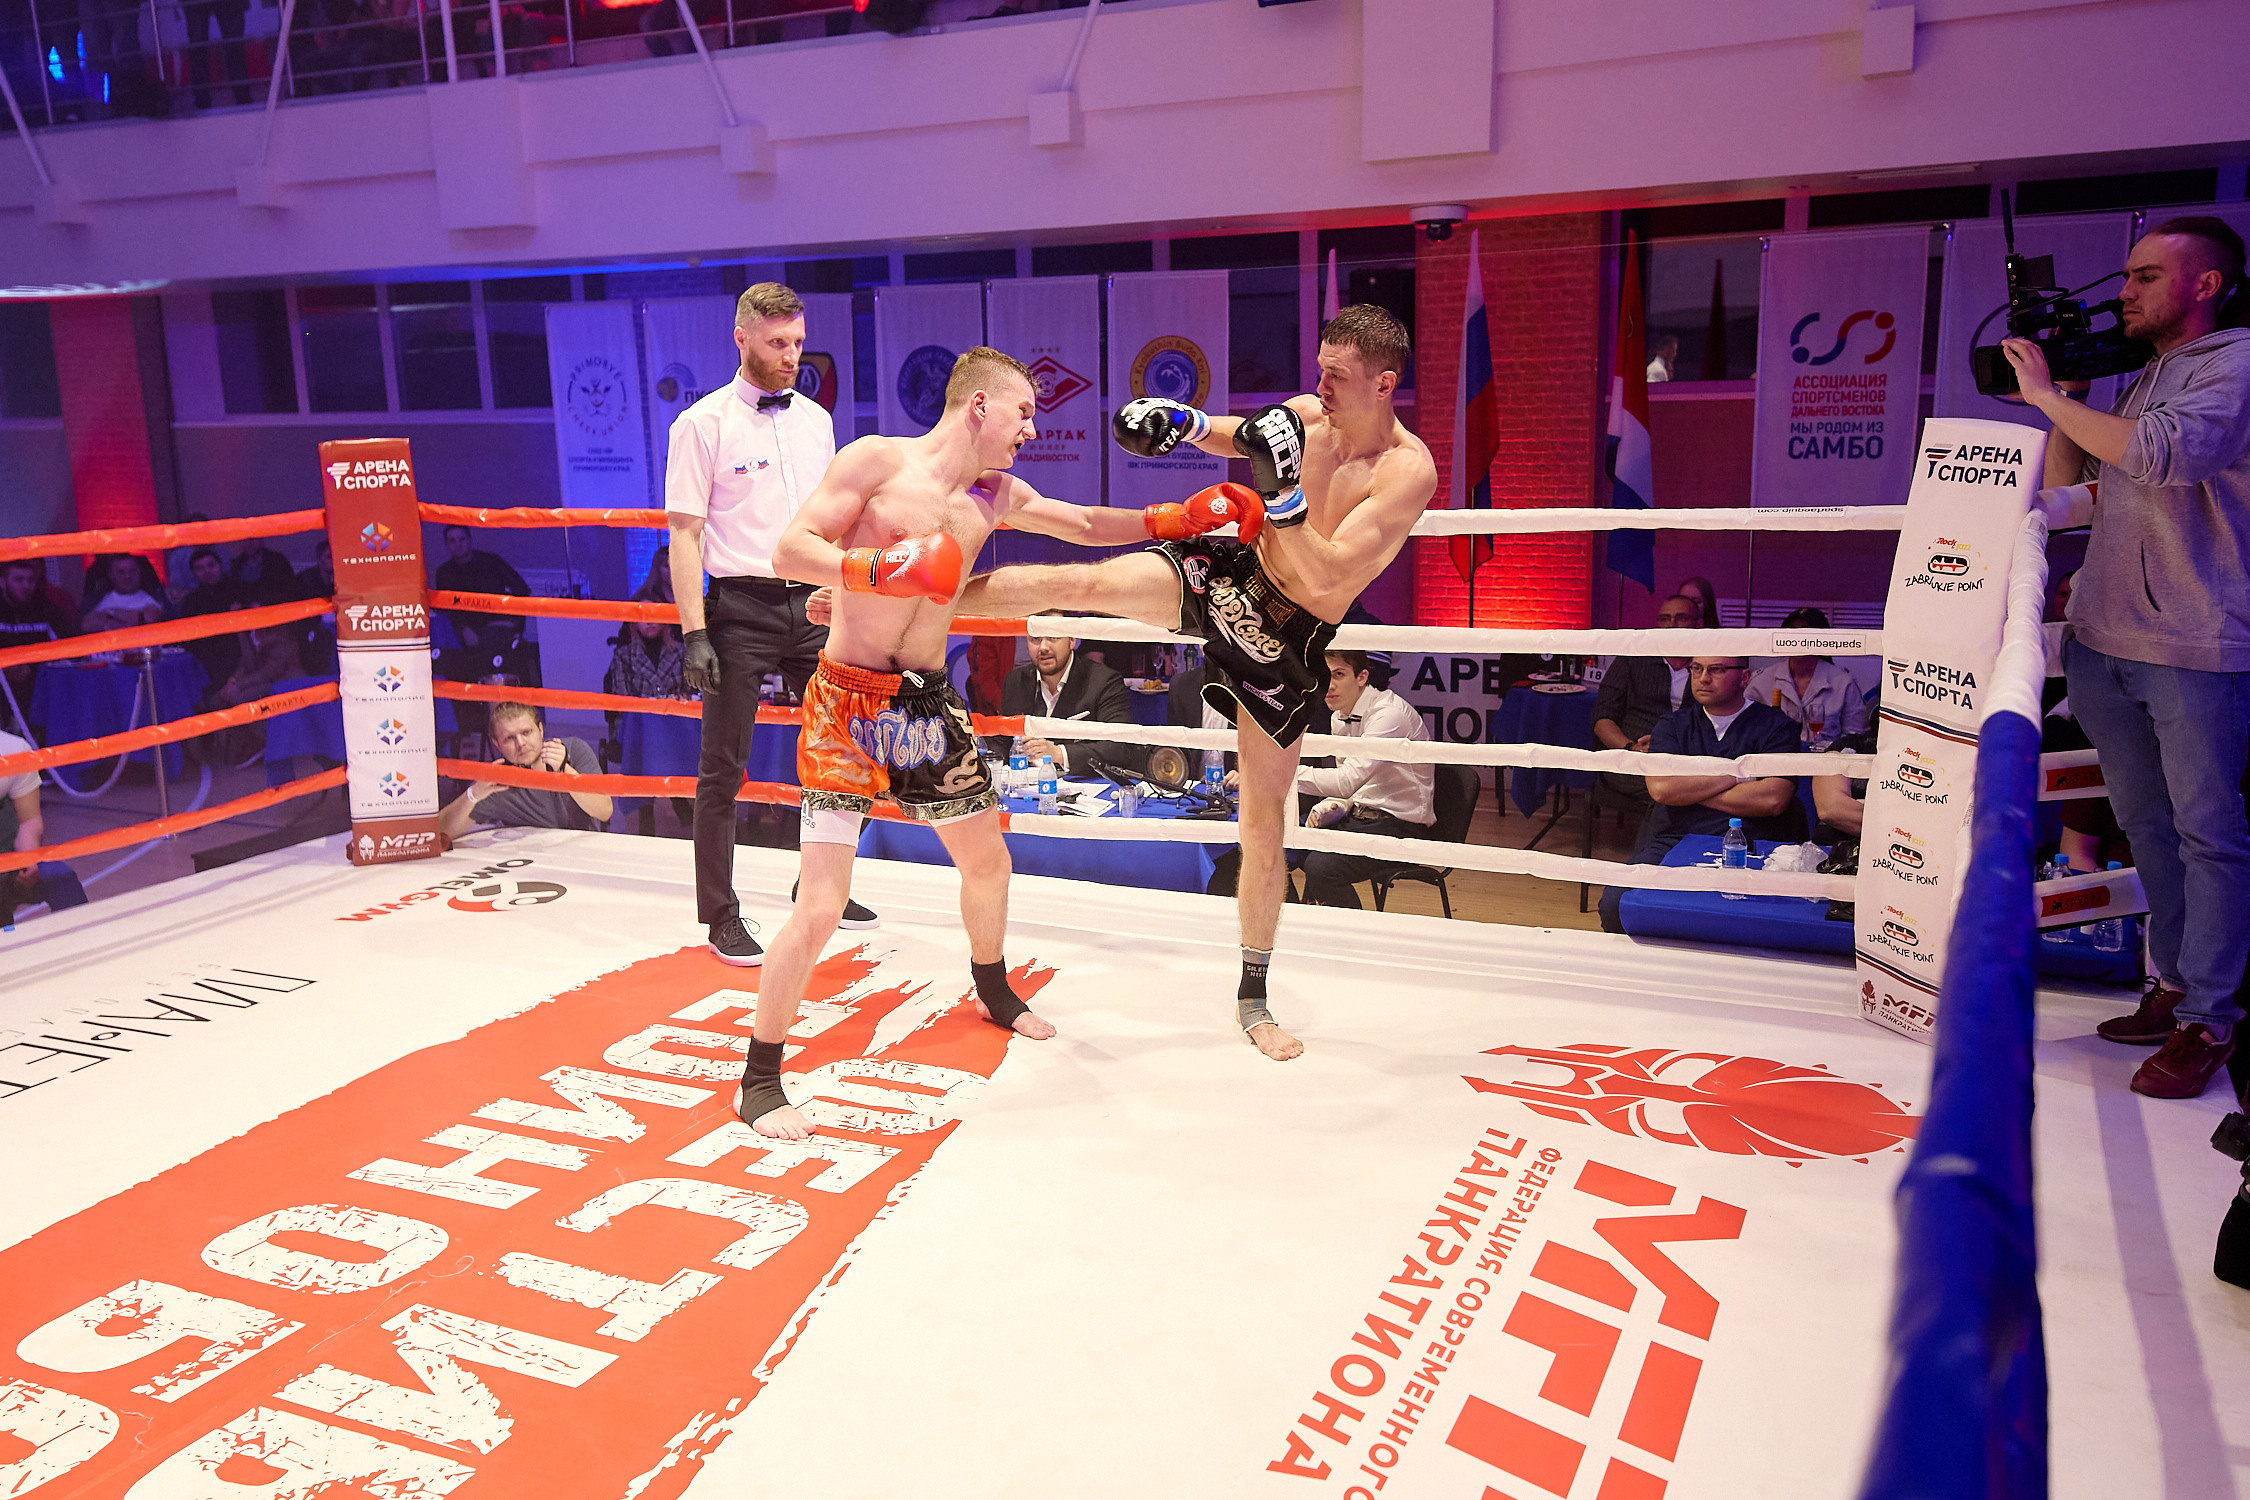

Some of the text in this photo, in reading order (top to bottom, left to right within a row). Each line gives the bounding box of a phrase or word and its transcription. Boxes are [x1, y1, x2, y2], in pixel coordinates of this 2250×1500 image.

[1793, 373, 1887, 390] АССОЦИАЦИЯ
[1791, 389, 1886, 404] СПОРТСМЕНОВ
[1790, 404, 1885, 418] ДАЛЬНЕГО ВОСТОКА
[1036, 429, 1086, 441] АРТАК
[1790, 421, 1884, 435] МЫ РОДОМ ИЗ
[1254, 414, 1292, 479] HILL
[1268, 408, 1301, 480] GREEN
[1787, 435, 1884, 460] САМБО
[1954, 444, 2023, 466] АРЕНА
[353, 459, 410, 475] АРЕНА
[343, 473, 412, 490] СПОРТА
[1938, 464, 2018, 487] СПОРТА
[1957, 578, 1985, 592] POINT
[370, 603, 426, 618] АРЕНА
[360, 617, 426, 632] СПОРТА
[1776, 638, 1862, 650] spartaequip.com
[1411, 656, 1500, 696] АРЕ
[1589, 670, 1602, 680] 18
[1913, 660, 1977, 689] АРЕНА
[1903, 677, 1974, 710] СПОРТА
[1925, 794, 1949, 804] POINT
[380, 831, 436, 849] MFP
[1916, 874, 1939, 886] POINT
[1912, 951, 1934, 963] POINT
[1475, 1146, 1563, 1275] ФЕДЕРАЦИЯ
[1265, 1127, 1528, 1481] ПАНКРАТИОНА
